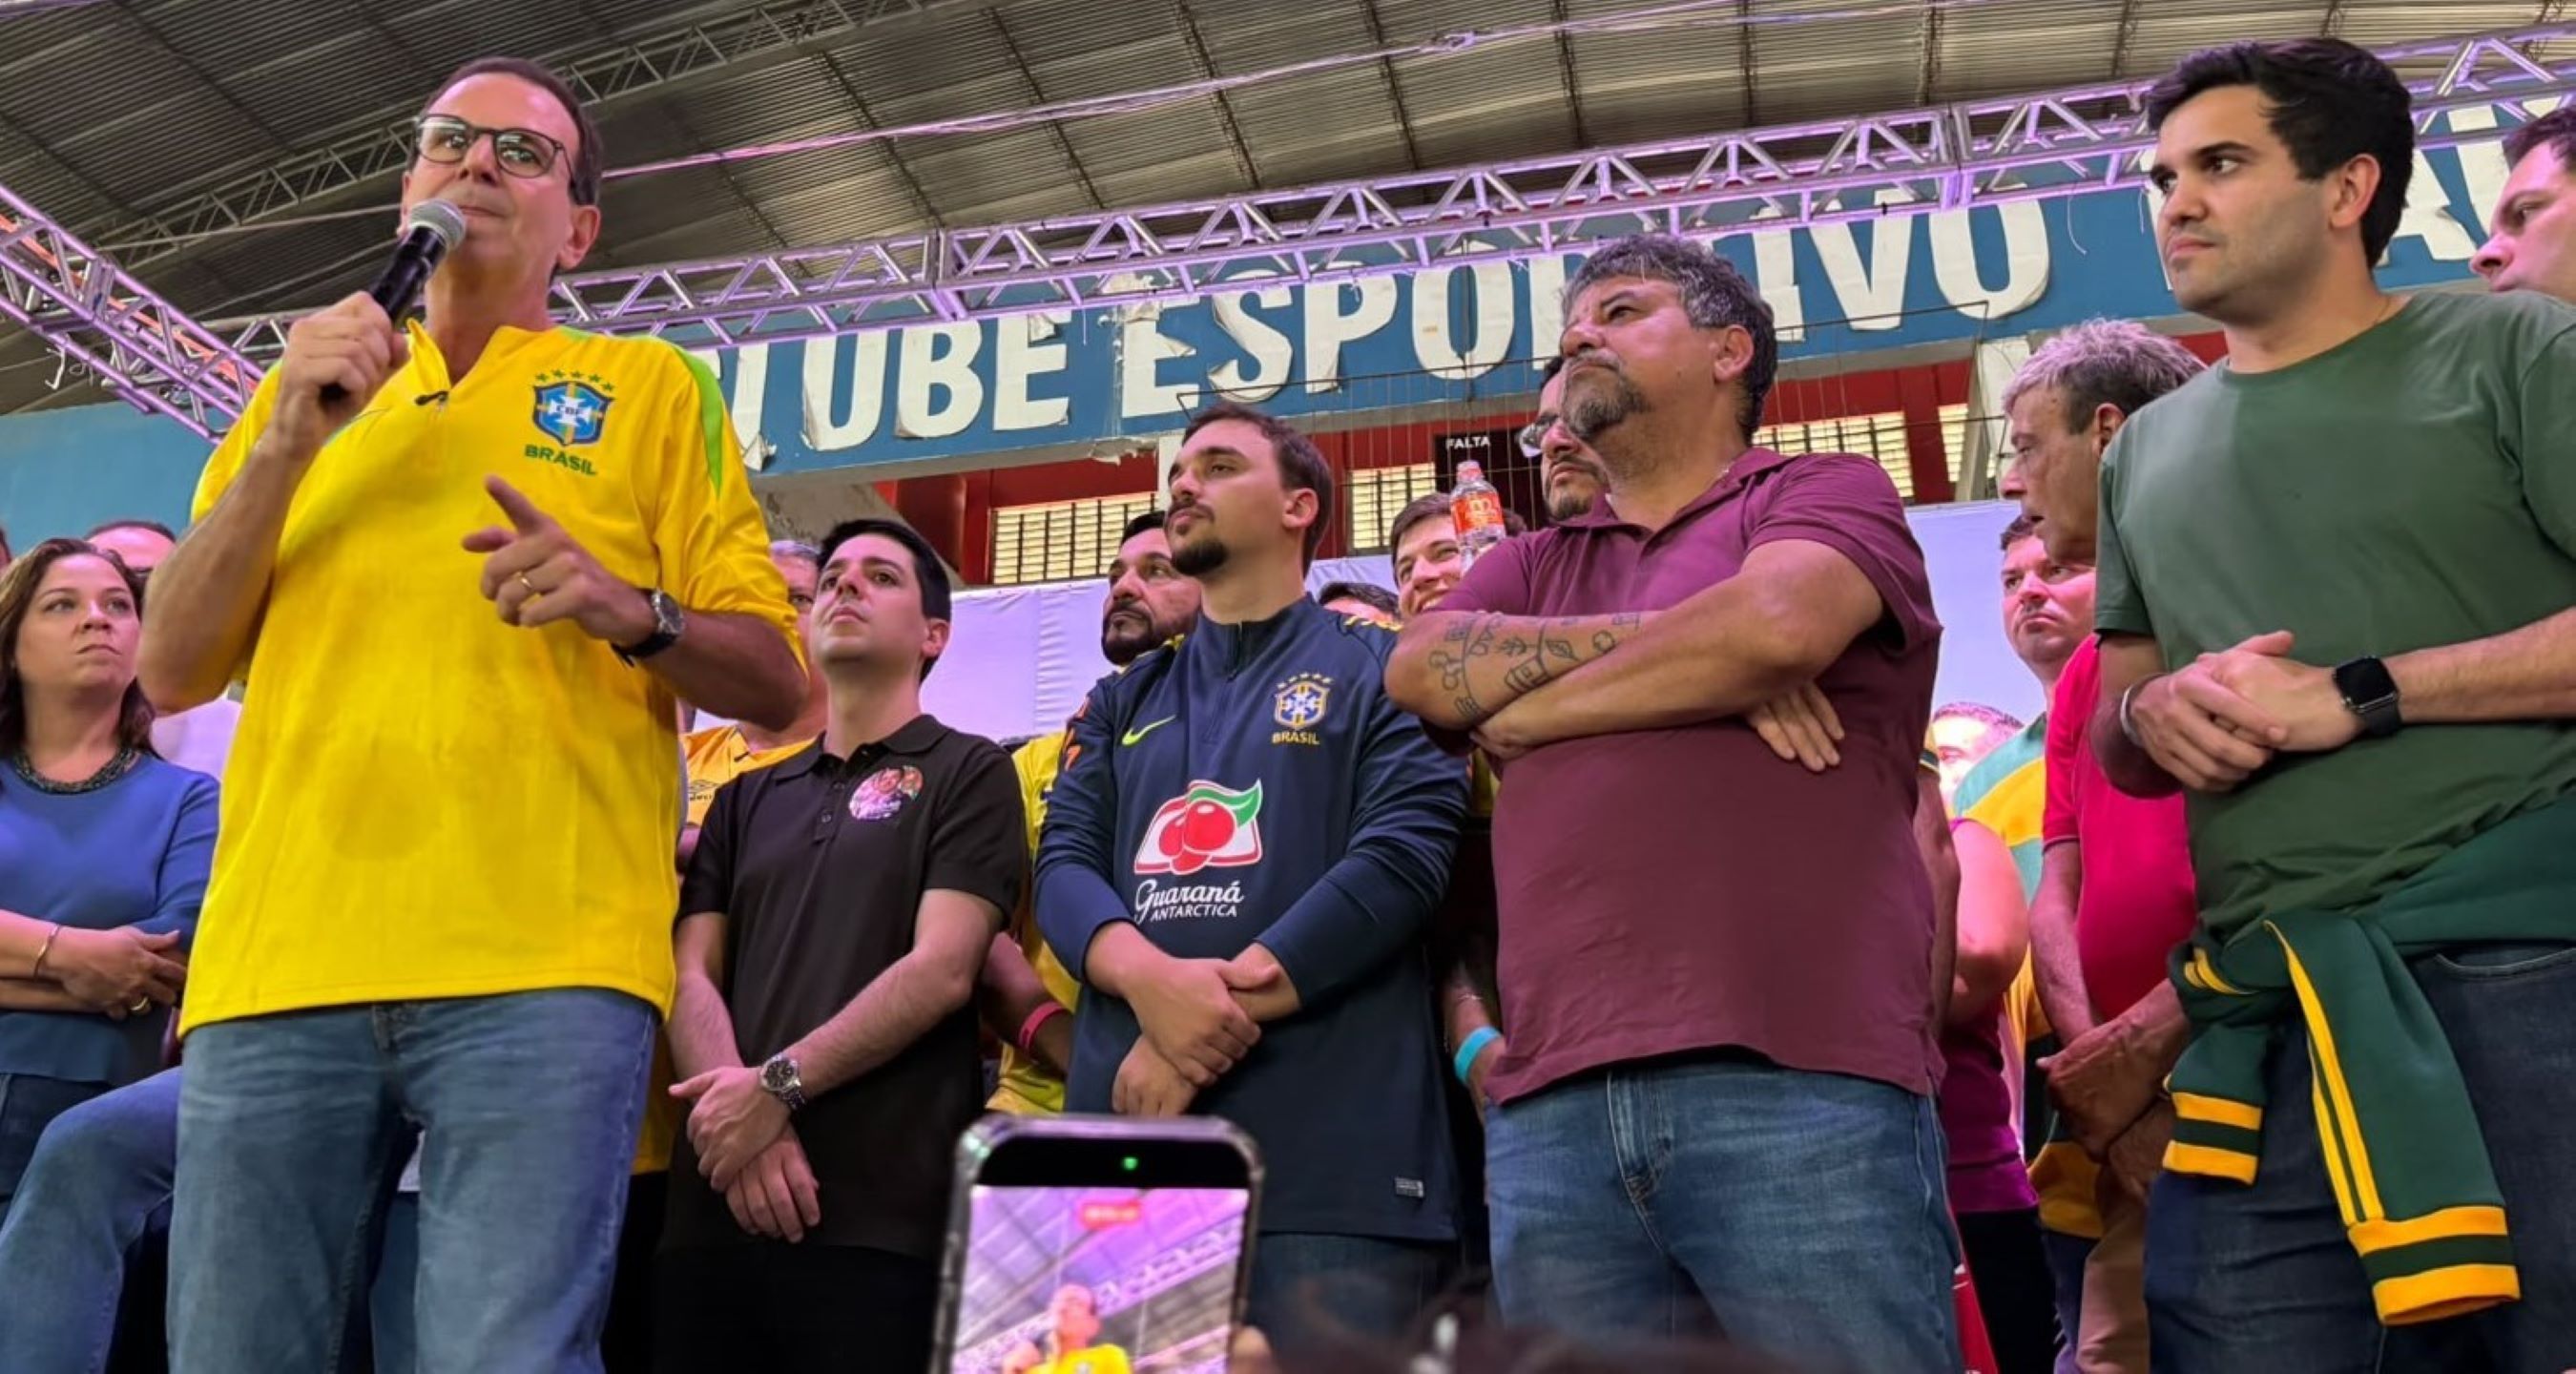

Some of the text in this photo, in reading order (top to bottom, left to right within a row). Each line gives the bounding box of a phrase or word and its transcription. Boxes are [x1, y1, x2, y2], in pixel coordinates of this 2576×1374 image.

[687, 307, 1072, 471] LUBE
[1103, 183, 2050, 419] ESPOIVO
[1446, 436, 1490, 449] FALTA
[526, 445, 596, 475] BRASIL
[1272, 731, 1320, 745] BRASIL
[1134, 878, 1244, 924] Guaraná
[1151, 904, 1238, 922] ANTARCTICA
